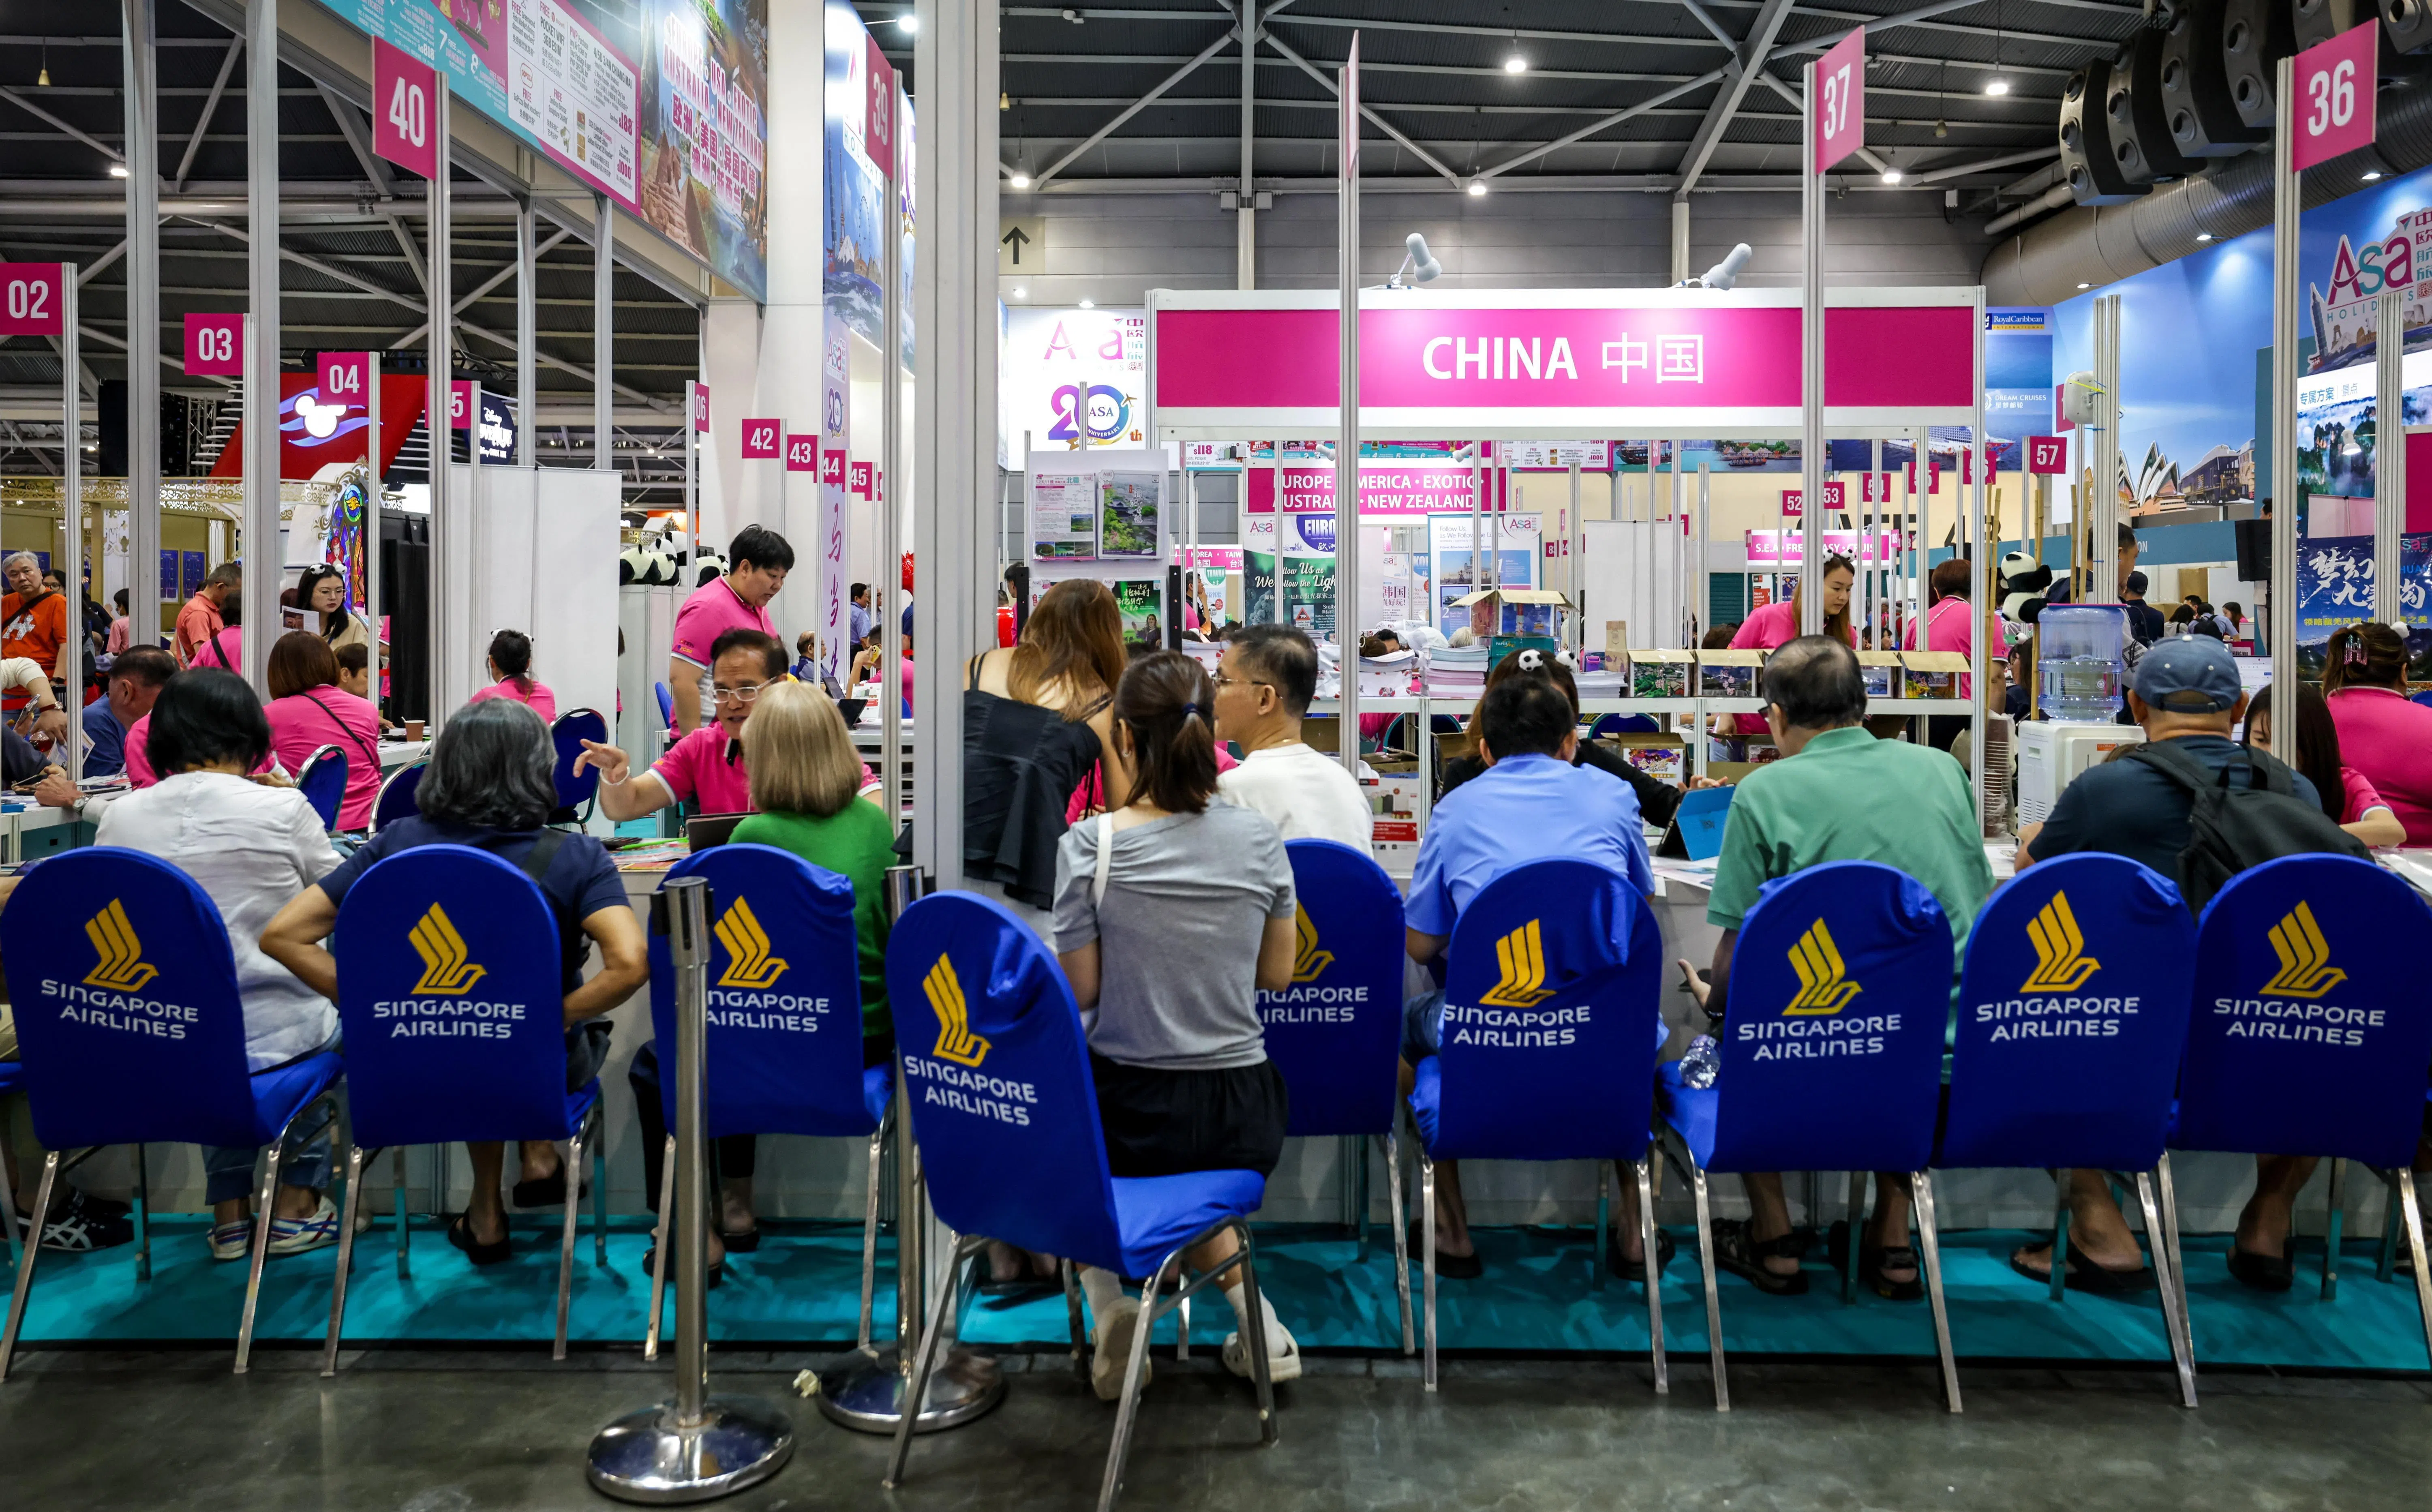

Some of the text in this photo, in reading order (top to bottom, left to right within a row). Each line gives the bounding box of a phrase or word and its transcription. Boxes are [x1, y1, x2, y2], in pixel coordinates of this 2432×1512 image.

[512, 0, 521, 16] FREE
[540, 0, 550, 19] FREE
[540, 16, 555, 38] POCKET
[439, 29, 447, 50] 7
[543, 32, 551, 48] 3GB
[471, 54, 479, 74] 8
[594, 47, 602, 62] 4/5D
[603, 54, 611, 71] 3/4N
[612, 64, 625, 83] CHIANG
[671, 15, 756, 131] EUROPE USA EXOTIC
[522, 88, 531, 103] FREE
[554, 88, 562, 103] FREE
[664, 44, 762, 169] AUSTRALIA NEW ZEALAND
[1824, 63, 1851, 140] 37
[2308, 59, 2355, 137] 36
[390, 76, 424, 148] 40
[873, 72, 888, 146] 39
[673, 93, 693, 138] 欧洲
[701, 119, 717, 159] 美国
[844, 128, 882, 186] HOLIDAYS
[692, 147, 741, 213] 澳洲 新西兰
[2328, 237, 2413, 306] Asa
[8, 280, 49, 319] 02
[2327, 291, 2413, 323] HOLIDS
[199, 328, 232, 360] 03
[1044, 320, 1123, 360] Aa
[828, 336, 841, 371] Asa
[1422, 333, 1703, 384] CHINA 中国
[330, 365, 359, 393] 04
[451, 392, 464, 418] 5
[2300, 383, 2358, 405] 专属方案 景点
[696, 394, 706, 421] 06
[828, 388, 842, 433] 20
[1049, 385, 1129, 440] 20
[1089, 407, 1114, 417] ASA
[750, 427, 773, 450] 42
[1088, 426, 1120, 437] NNIVERSARY
[1130, 430, 1143, 441] th
[790, 443, 811, 463] 43
[2036, 445, 2058, 465] 57
[823, 457, 839, 476] 44
[851, 469, 866, 486] 45
[1274, 475, 1332, 489] UROPE
[1368, 495, 1404, 508] NEW
[1406, 495, 1473, 508] ZEALAND
[1787, 496, 1802, 510] 52
[1824, 488, 1839, 503] 53
[1250, 521, 1273, 532] Asa
[1305, 519, 1335, 537] EURO
[1510, 518, 1531, 529] Asa
[1824, 544, 1840, 552] ASY
[1299, 562, 1314, 574] Us
[1498, 558, 1503, 573] 1
[2400, 564, 2428, 574] HUAN
[1255, 576, 1275, 588] We
[1383, 586, 1406, 598] 韩国
[1442, 607, 1449, 618] 2
[41, 979, 199, 1022] SINGAPORE
[708, 990, 830, 1013] NGAPORE
[1256, 987, 1368, 1003] NGAPORE
[374, 1000, 526, 1020] SINGAPORE
[1257, 1007, 1354, 1023] IRLINES
[1443, 1005, 1591, 1027] SINGAPORE
[1976, 997, 2140, 1022] SINGAPORE
[2214, 998, 2385, 1028] SINGAPORE
[60, 1005, 186, 1040] AIRLINES
[391, 1022, 512, 1039] AIRLINES
[706, 1010, 818, 1032] AIRLINES
[1738, 1014, 1901, 1041] SINGAPORE
[1990, 1019, 2120, 1043] AIRLINES
[1454, 1028, 1576, 1047] AIRLINES
[2226, 1020, 2366, 1047] AIRLINES
[1753, 1037, 1884, 1061] AIRLINES
[905, 1056, 1038, 1103] SINGAPORE
[925, 1086, 1030, 1125] AIRLINES
